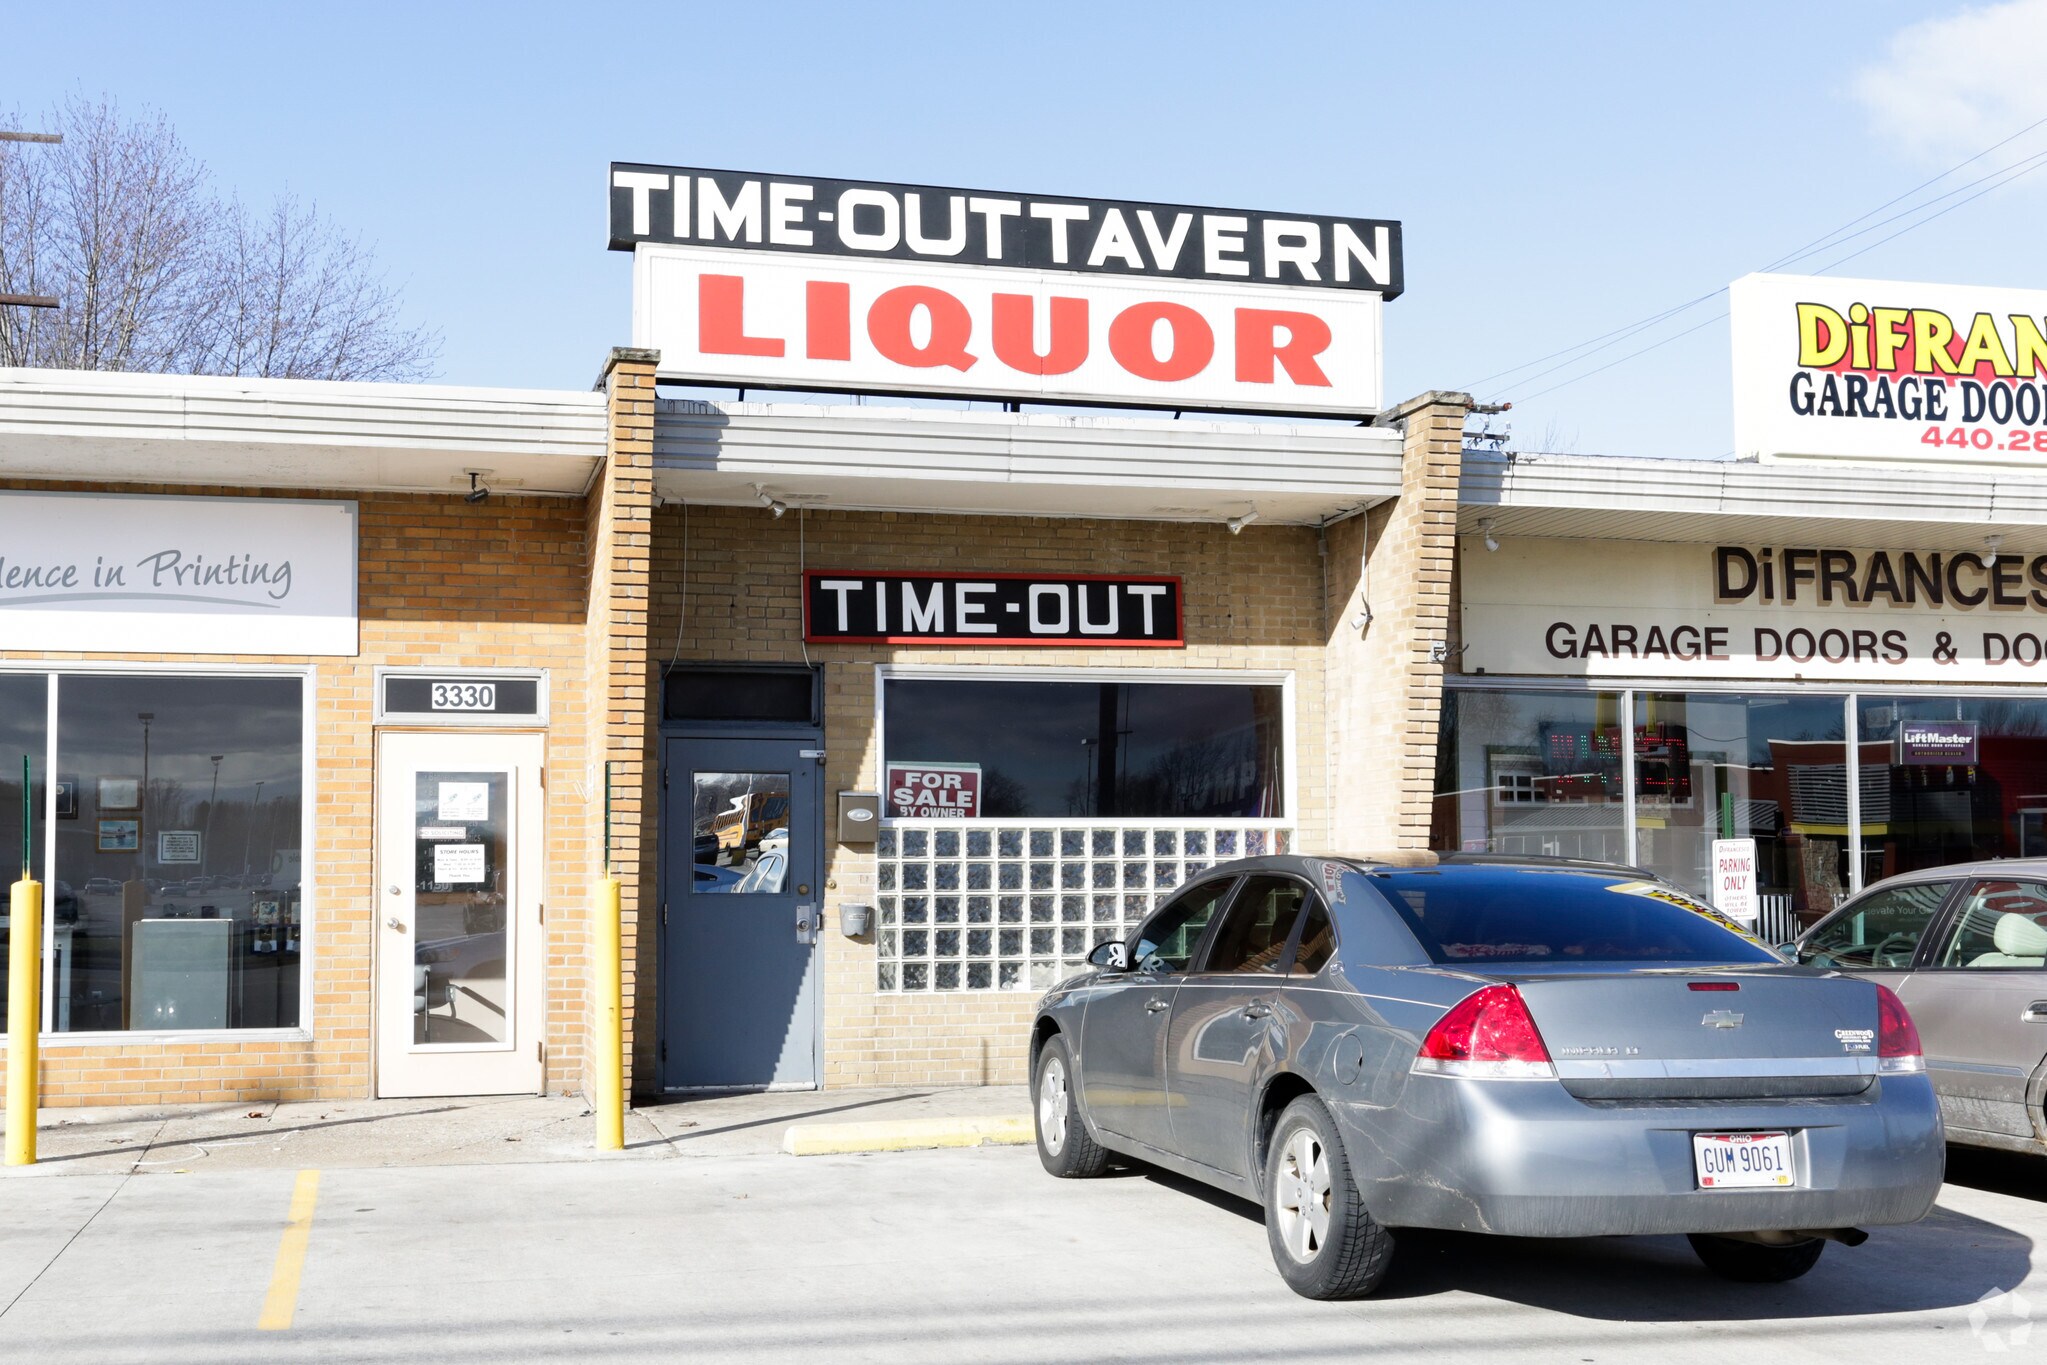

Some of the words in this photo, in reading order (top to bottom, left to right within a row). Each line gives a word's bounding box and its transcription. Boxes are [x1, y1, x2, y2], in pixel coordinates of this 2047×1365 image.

[613, 170, 1022, 260] TIME-OUT
[1029, 202, 1392, 286] TAVERN
[698, 273, 1333, 388] LIQUOR
[1789, 371, 1948, 422] GARAGE
[1960, 379, 2047, 427] DOO
[93, 556, 126, 588] in
[136, 549, 292, 600] Printing
[820, 579, 1167, 635] TIME-OUT
[1545, 621, 1730, 662] GARAGE
[1753, 627, 1909, 665] DOORS
[1932, 630, 1960, 665] &
[1983, 632, 2047, 668] DO
[434, 684, 493, 708] 3330
[1904, 732, 1973, 744] LiftMaster
[905, 772, 962, 789] FOR
[893, 787, 973, 808] SALE
[900, 805, 916, 817] BY
[920, 806, 966, 818] OWNER
[1719, 858, 1751, 873] PARKING
[1724, 876, 1747, 891] ONLY
[1897, 905, 1917, 915] Your
[1729, 1135, 1752, 1143] OHIO
[1703, 1147, 1736, 1174] GUM
[1740, 1145, 1783, 1172] 9061
